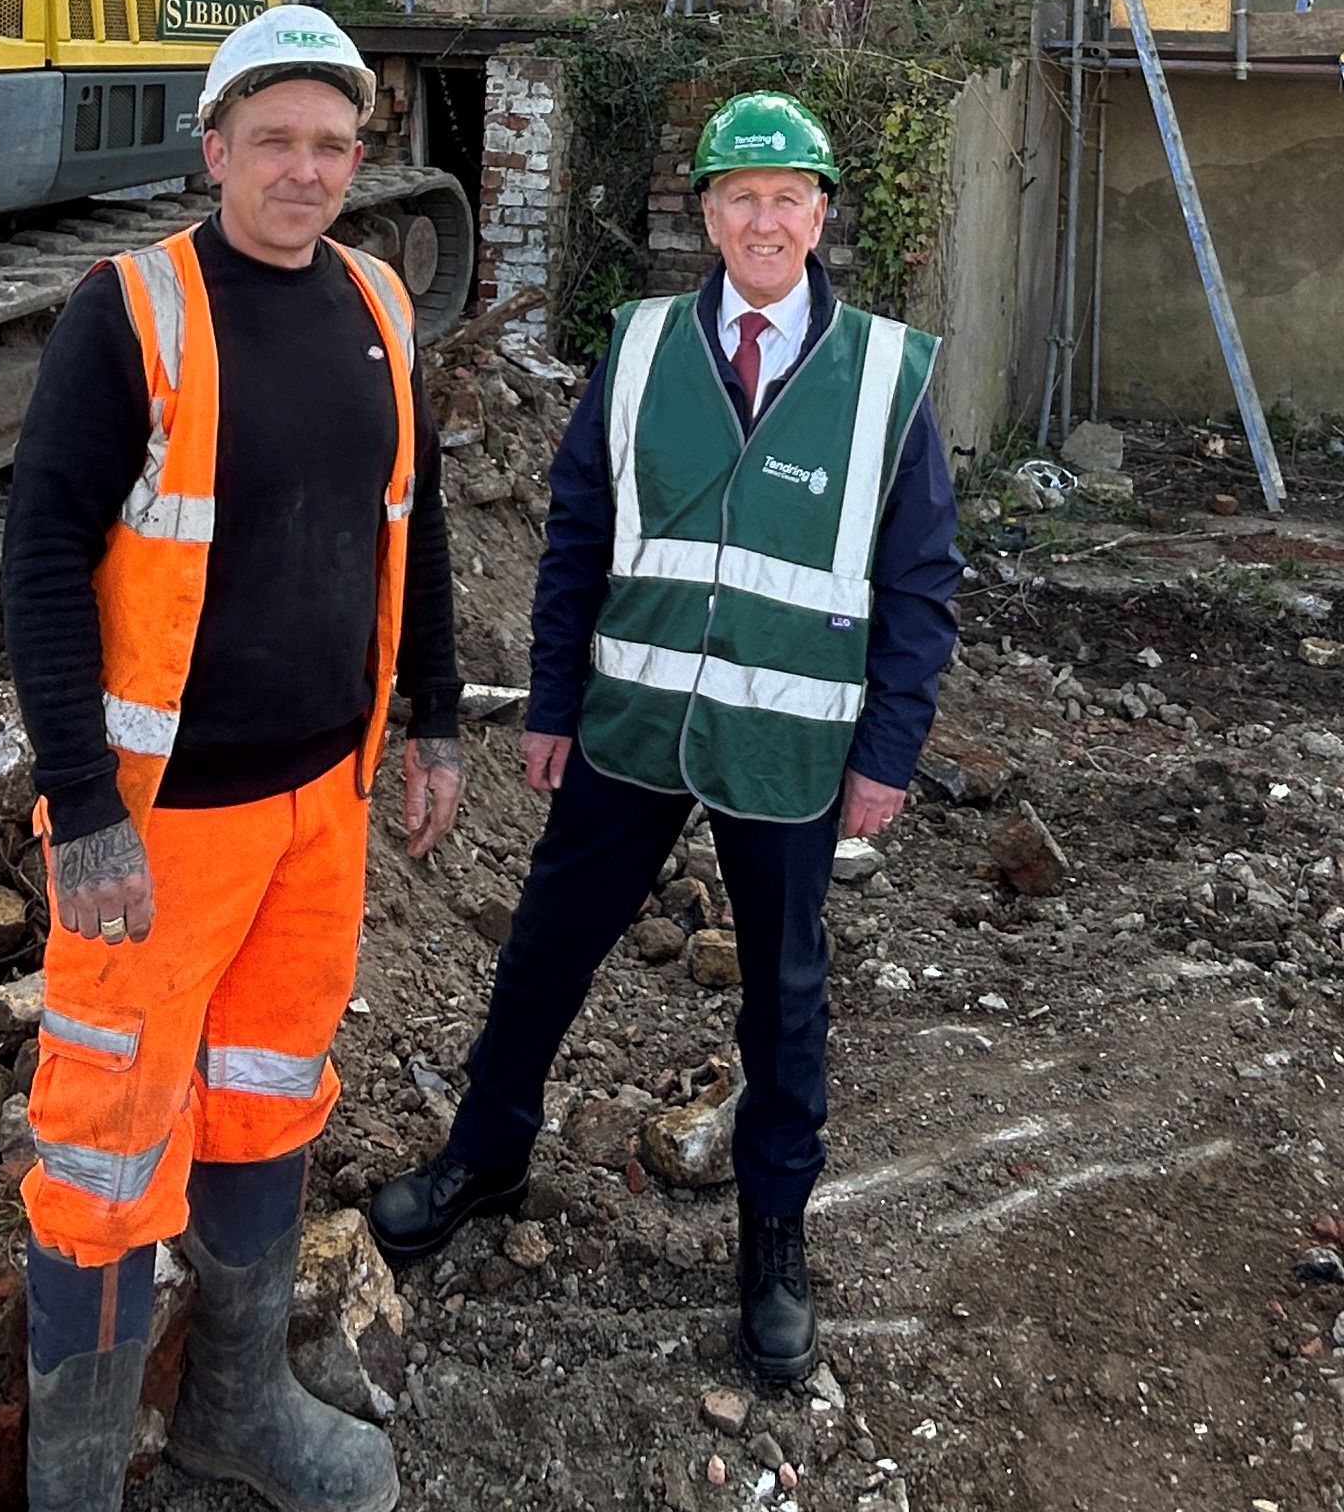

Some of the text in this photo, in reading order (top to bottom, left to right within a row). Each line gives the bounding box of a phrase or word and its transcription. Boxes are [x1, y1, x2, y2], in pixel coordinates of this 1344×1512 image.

[283, 32, 336, 44] SRC
[734, 134, 771, 145] Tendring
[765, 455, 810, 482] Tendring
